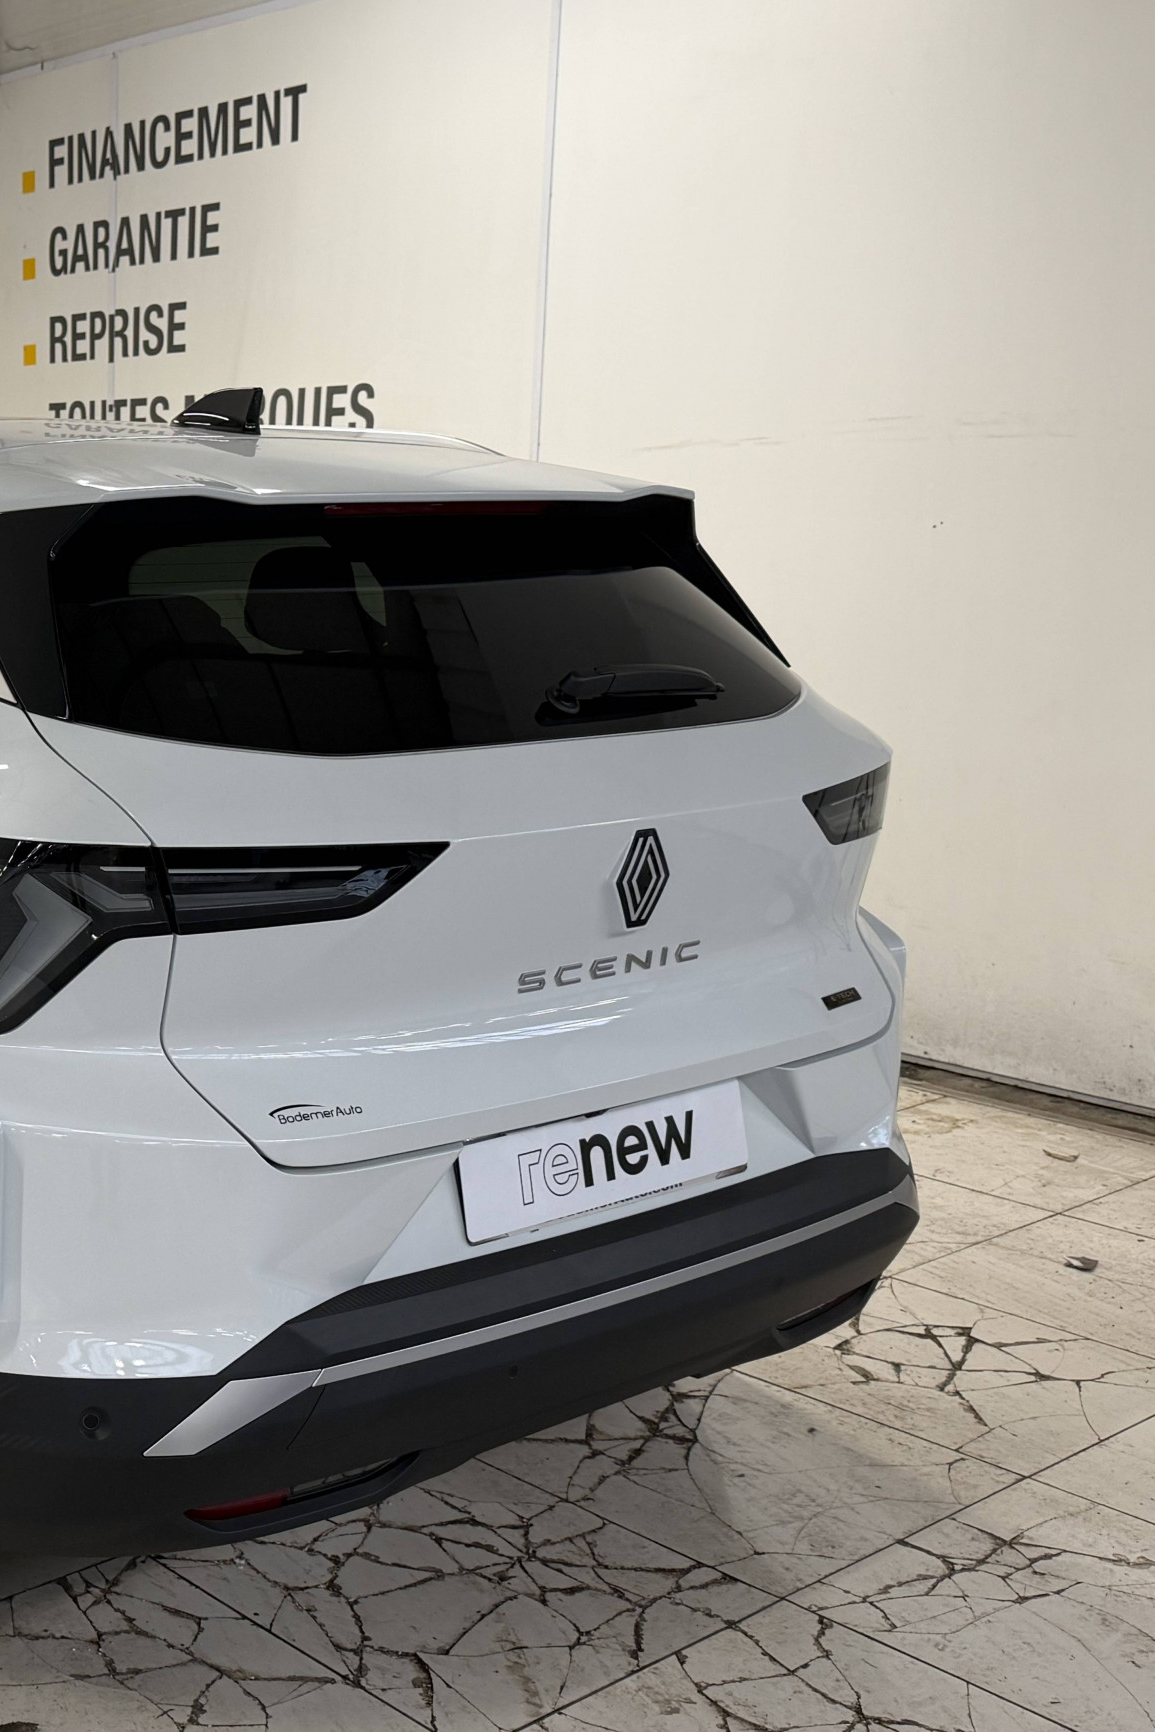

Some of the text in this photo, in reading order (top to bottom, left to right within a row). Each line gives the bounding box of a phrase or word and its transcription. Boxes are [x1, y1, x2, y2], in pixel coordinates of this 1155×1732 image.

[48, 83, 308, 189] FINANCEMENT
[49, 202, 221, 277] GARANTIE
[49, 301, 188, 364] REPRISE
[517, 940, 701, 994] SCENIC
[517, 1109, 694, 1206] renew
